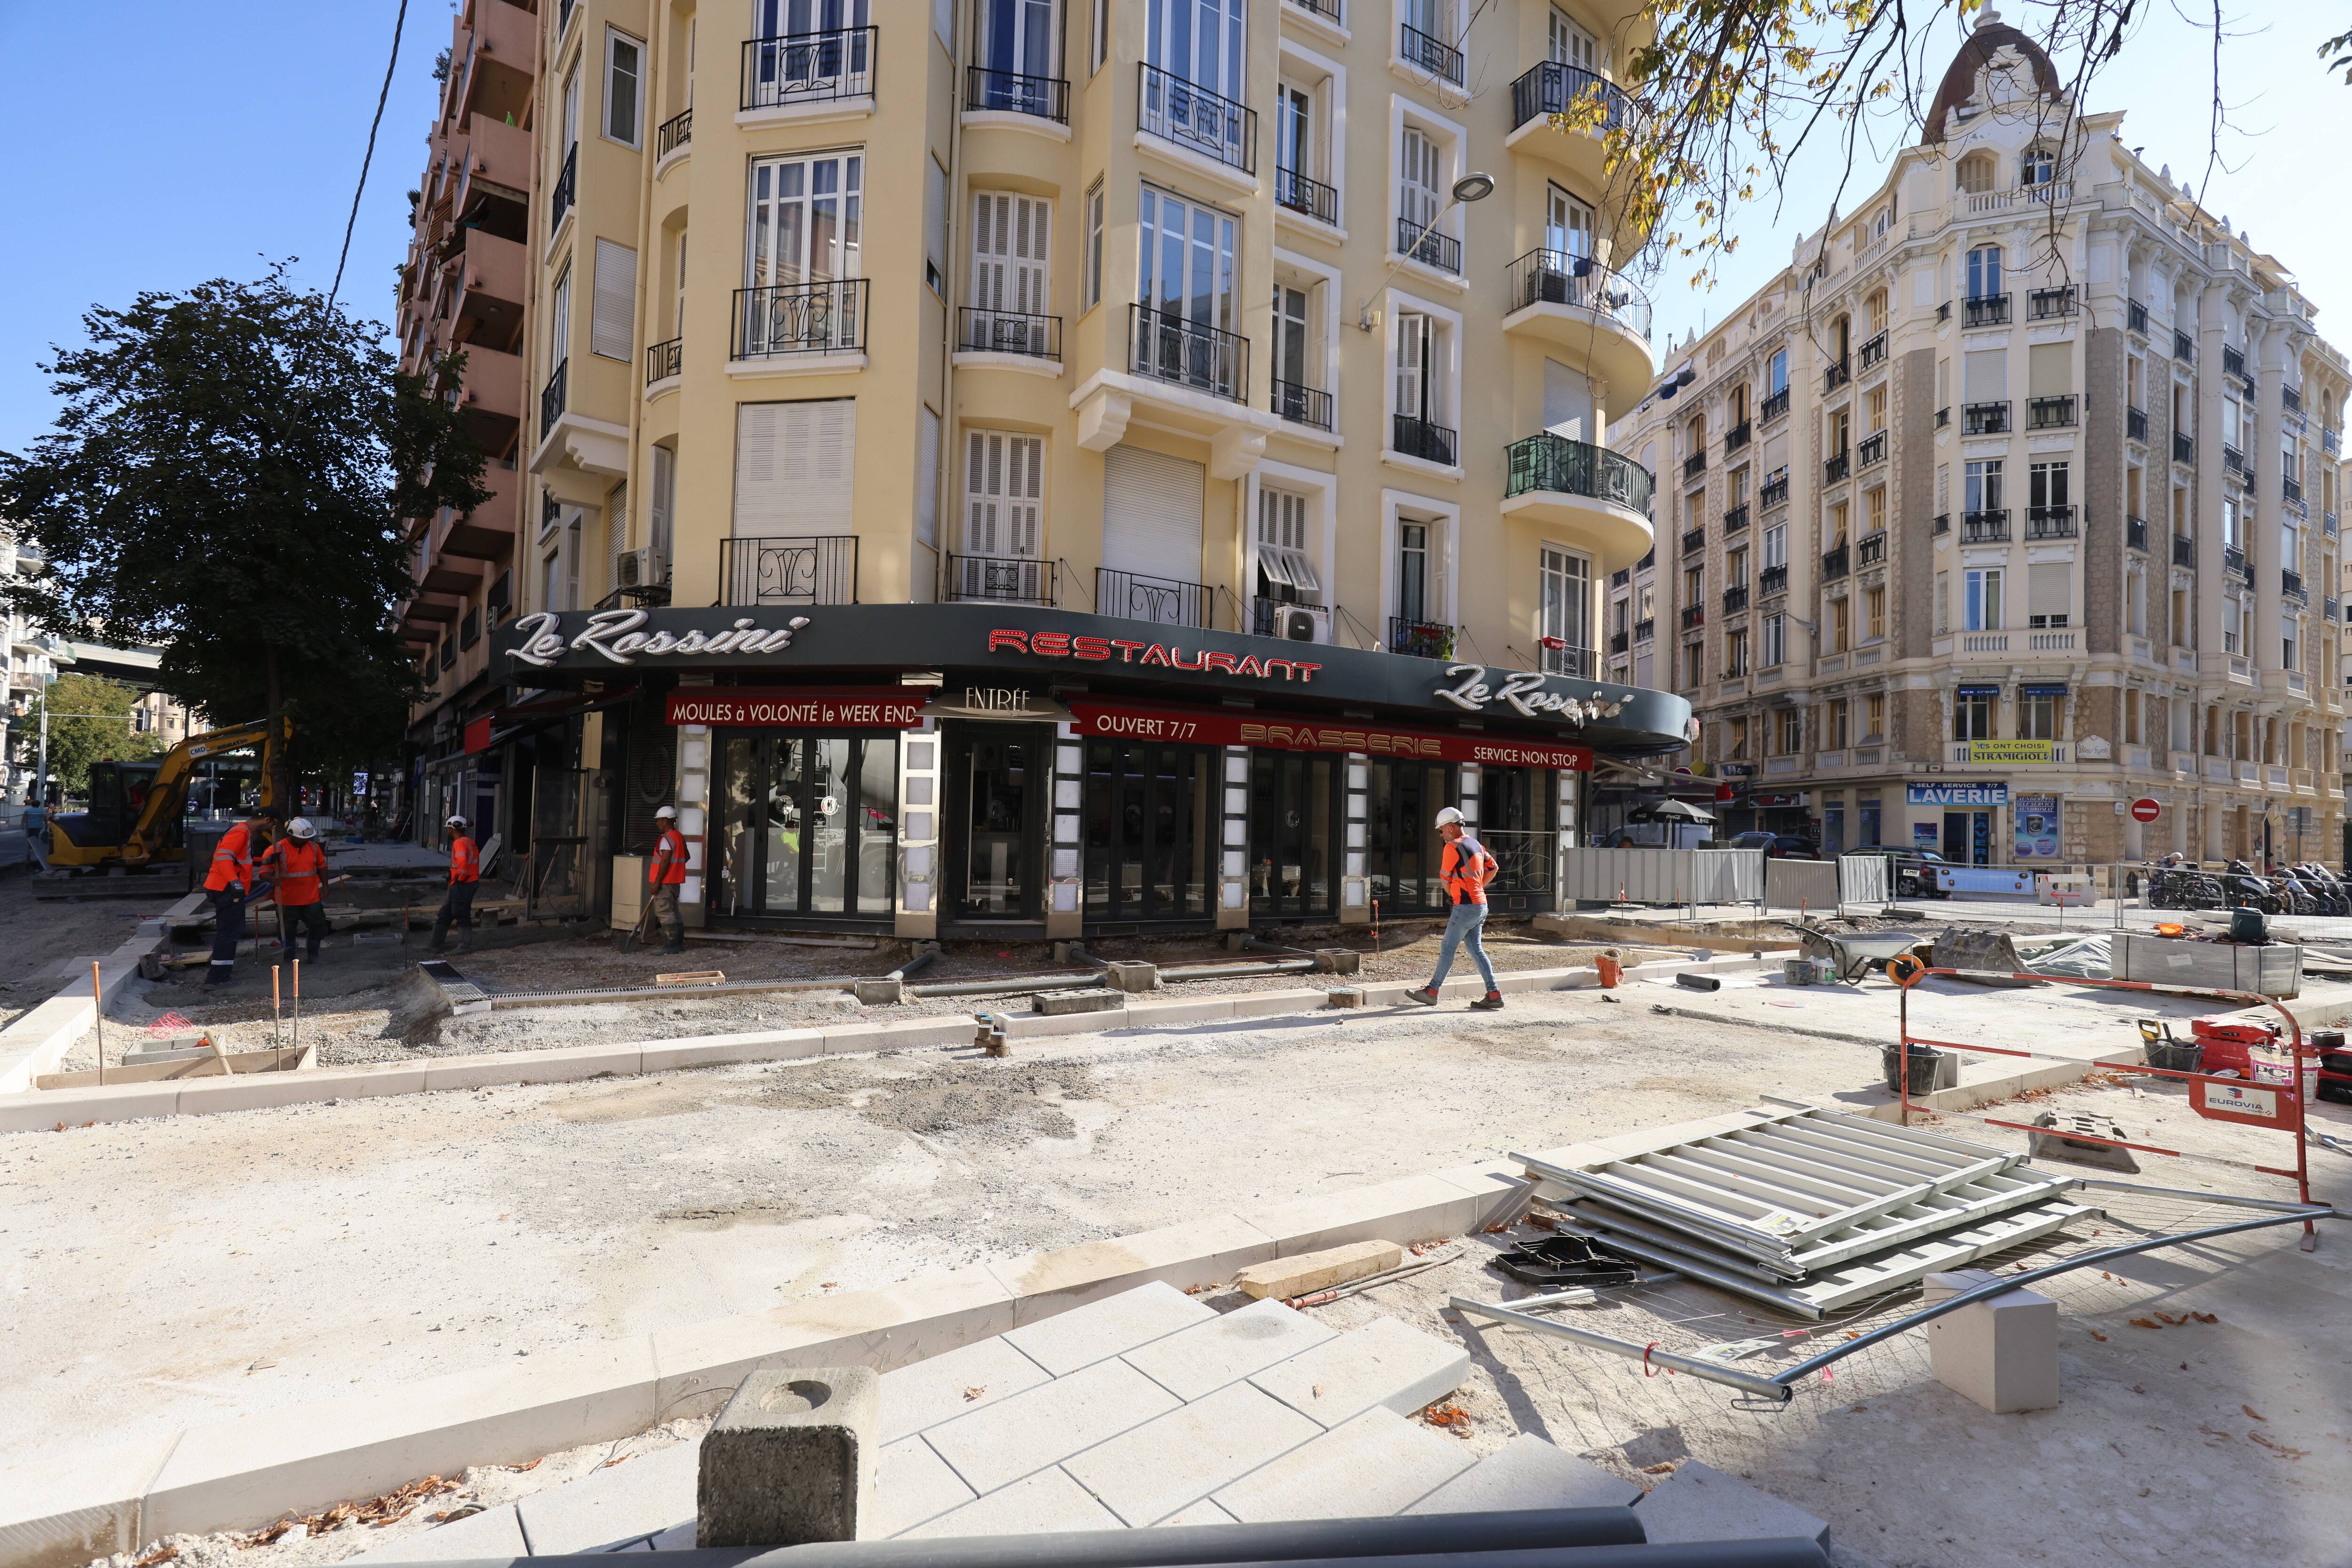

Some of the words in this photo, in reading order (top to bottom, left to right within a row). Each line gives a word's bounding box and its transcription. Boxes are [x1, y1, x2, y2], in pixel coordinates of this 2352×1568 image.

[505, 611, 567, 666] Le
[571, 609, 810, 665] Rossini
[989, 629, 1322, 682] RESTAURANT
[1433, 665, 1492, 711] Le
[673, 704, 731, 721] MOULES
[736, 705, 744, 721] à
[750, 700, 818, 722] VOLONTÉ
[822, 705, 834, 721] le
[839, 705, 879, 722] WEEK
[885, 705, 916, 722] END
[966, 685, 1030, 716] ENTRÉE
[1097, 715, 1164, 735] OUVERT
[1170, 722, 1197, 739] 7/7
[1241, 724, 1441, 756] BRASSERIE
[1474, 746, 1518, 762] SERVICE
[1521, 750, 1549, 765] NON
[1552, 752, 1578, 768] STOP
[1909, 789, 2005, 804] LAVERIE
[2256, 1065, 2292, 1079] PCI
[2209, 1097, 2264, 1110] EUROVIA
